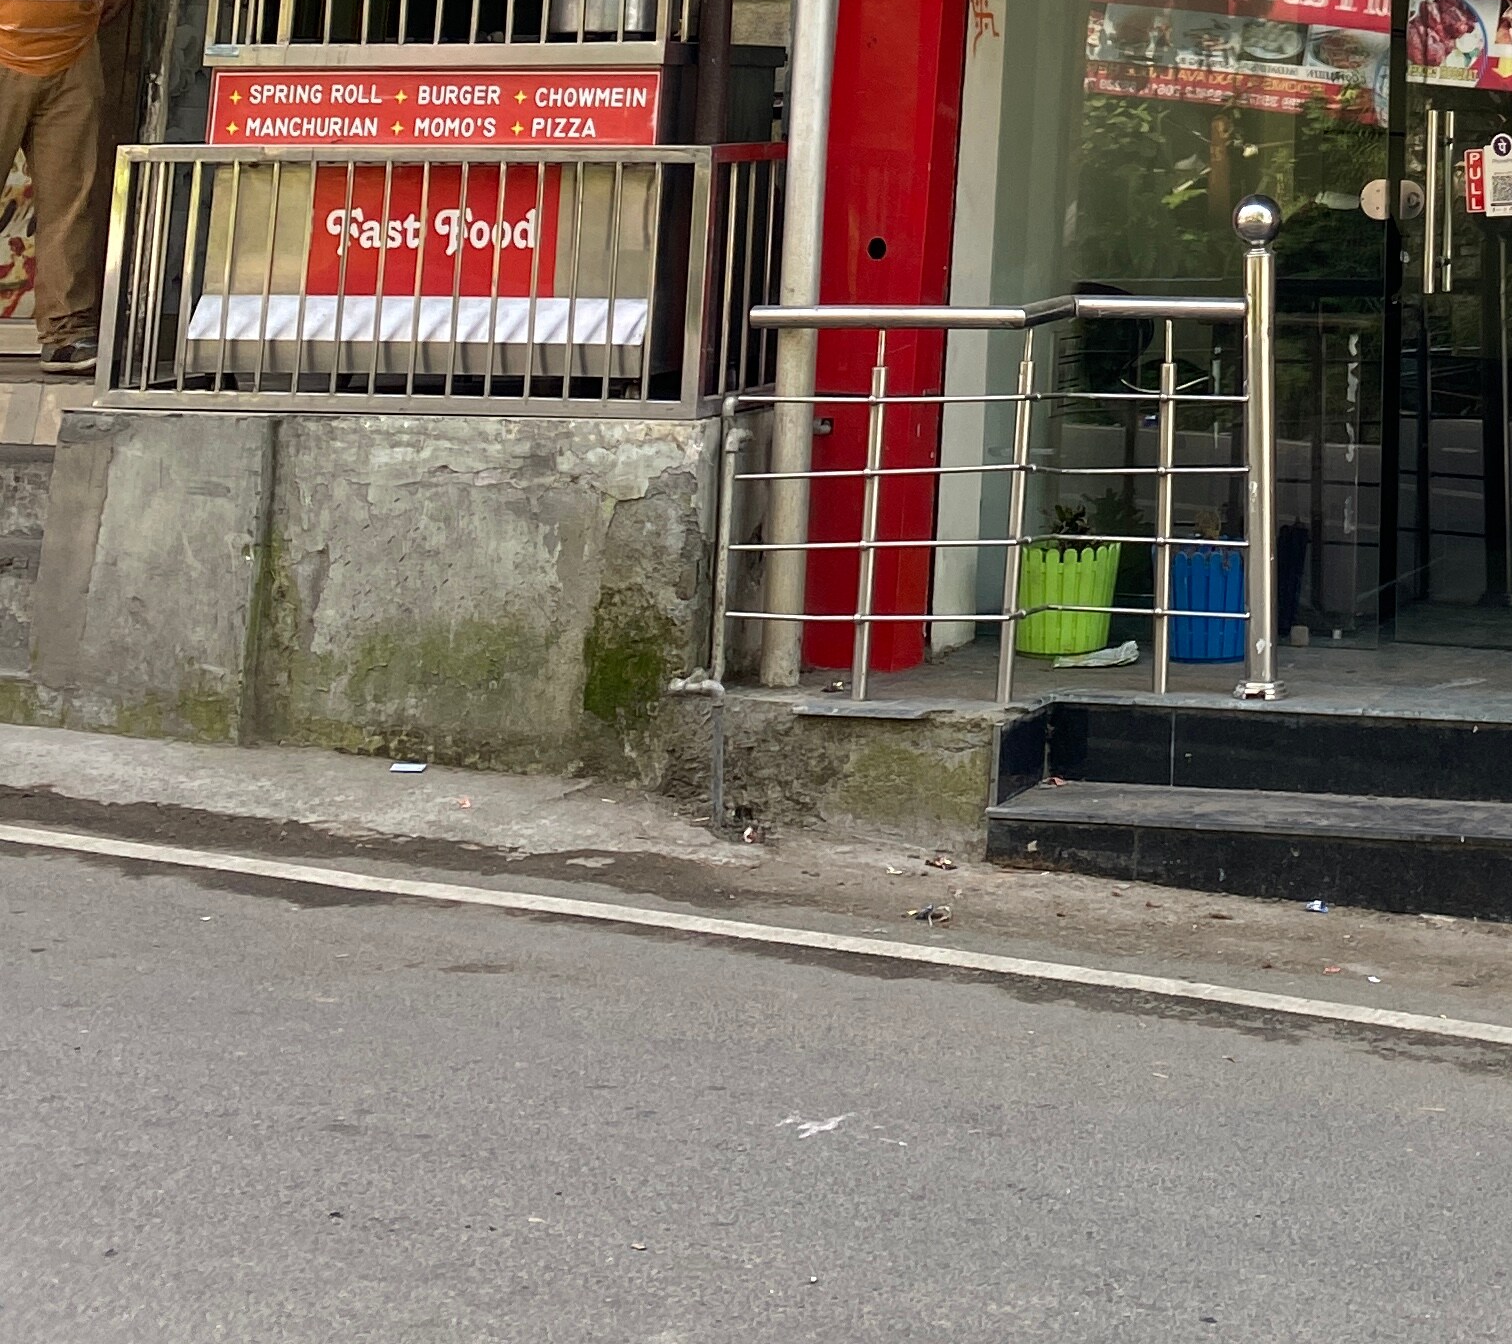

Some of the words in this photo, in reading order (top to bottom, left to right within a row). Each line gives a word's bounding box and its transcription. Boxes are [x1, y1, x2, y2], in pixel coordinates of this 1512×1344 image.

[249, 84, 322, 105] SPRING
[330, 84, 383, 104] ROLL
[417, 85, 500, 105] BURGER
[534, 87, 646, 108] CHOWMEIN
[245, 117, 377, 137] MANCHURIAN
[413, 118, 496, 137] MOMO'S
[531, 118, 597, 139] PIZZA
[1469, 153, 1481, 210] PULL
[326, 207, 421, 255] Fast
[434, 207, 537, 255] Food
